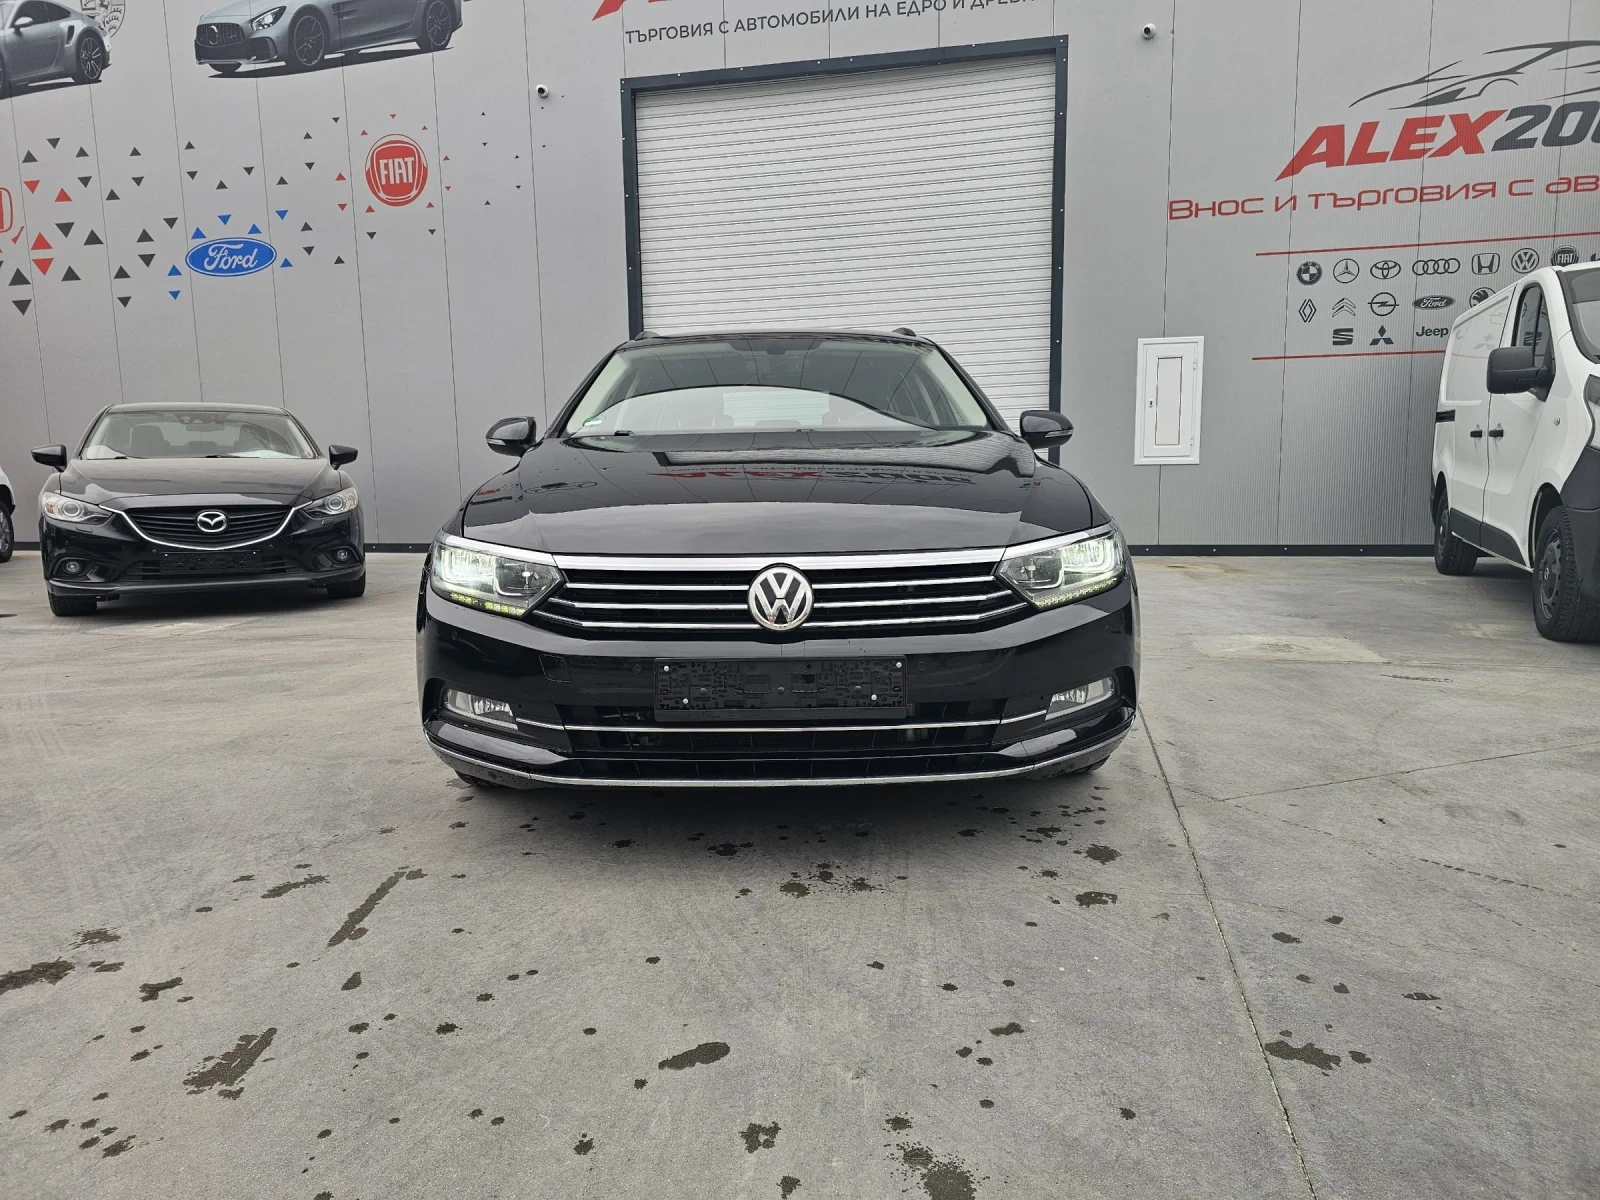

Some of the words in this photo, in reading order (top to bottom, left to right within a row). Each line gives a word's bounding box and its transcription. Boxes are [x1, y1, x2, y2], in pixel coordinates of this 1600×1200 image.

[625, 22, 714, 44] ТЪРГОВИЯ
[718, 20, 730, 34] С
[733, 6, 860, 33] АВТОМОБИЛИ
[865, 3, 892, 19] НА
[896, 0, 947, 17] ЕДРО
[1274, 100, 1600, 182] ALEX20
[378, 156, 415, 185] FIAT
[203, 243, 259, 270] Ford
[1557, 253, 1574, 264] FIAT
[1420, 297, 1448, 308] Ford
[1416, 326, 1449, 338] Jeep
